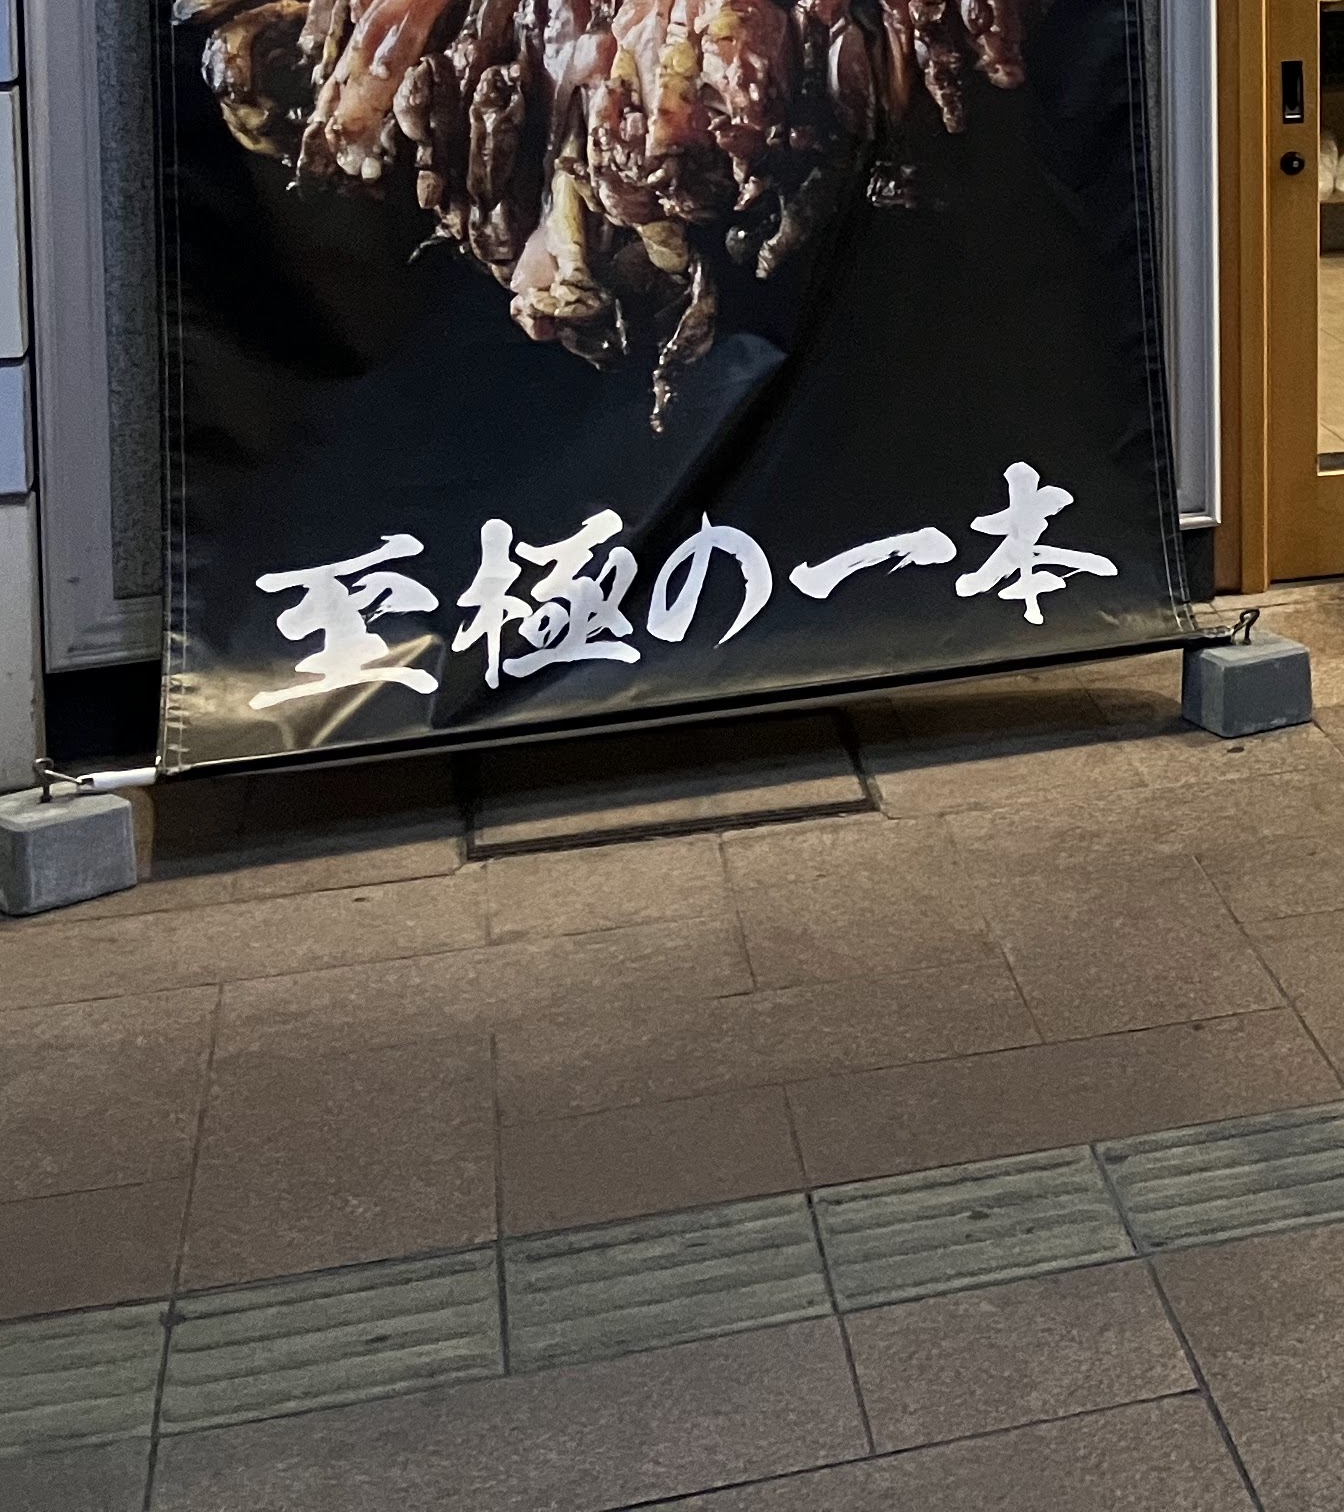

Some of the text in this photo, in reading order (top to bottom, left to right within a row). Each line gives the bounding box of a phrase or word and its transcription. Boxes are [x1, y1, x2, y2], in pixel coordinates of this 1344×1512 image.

[249, 461, 1118, 710] 至極の一本
